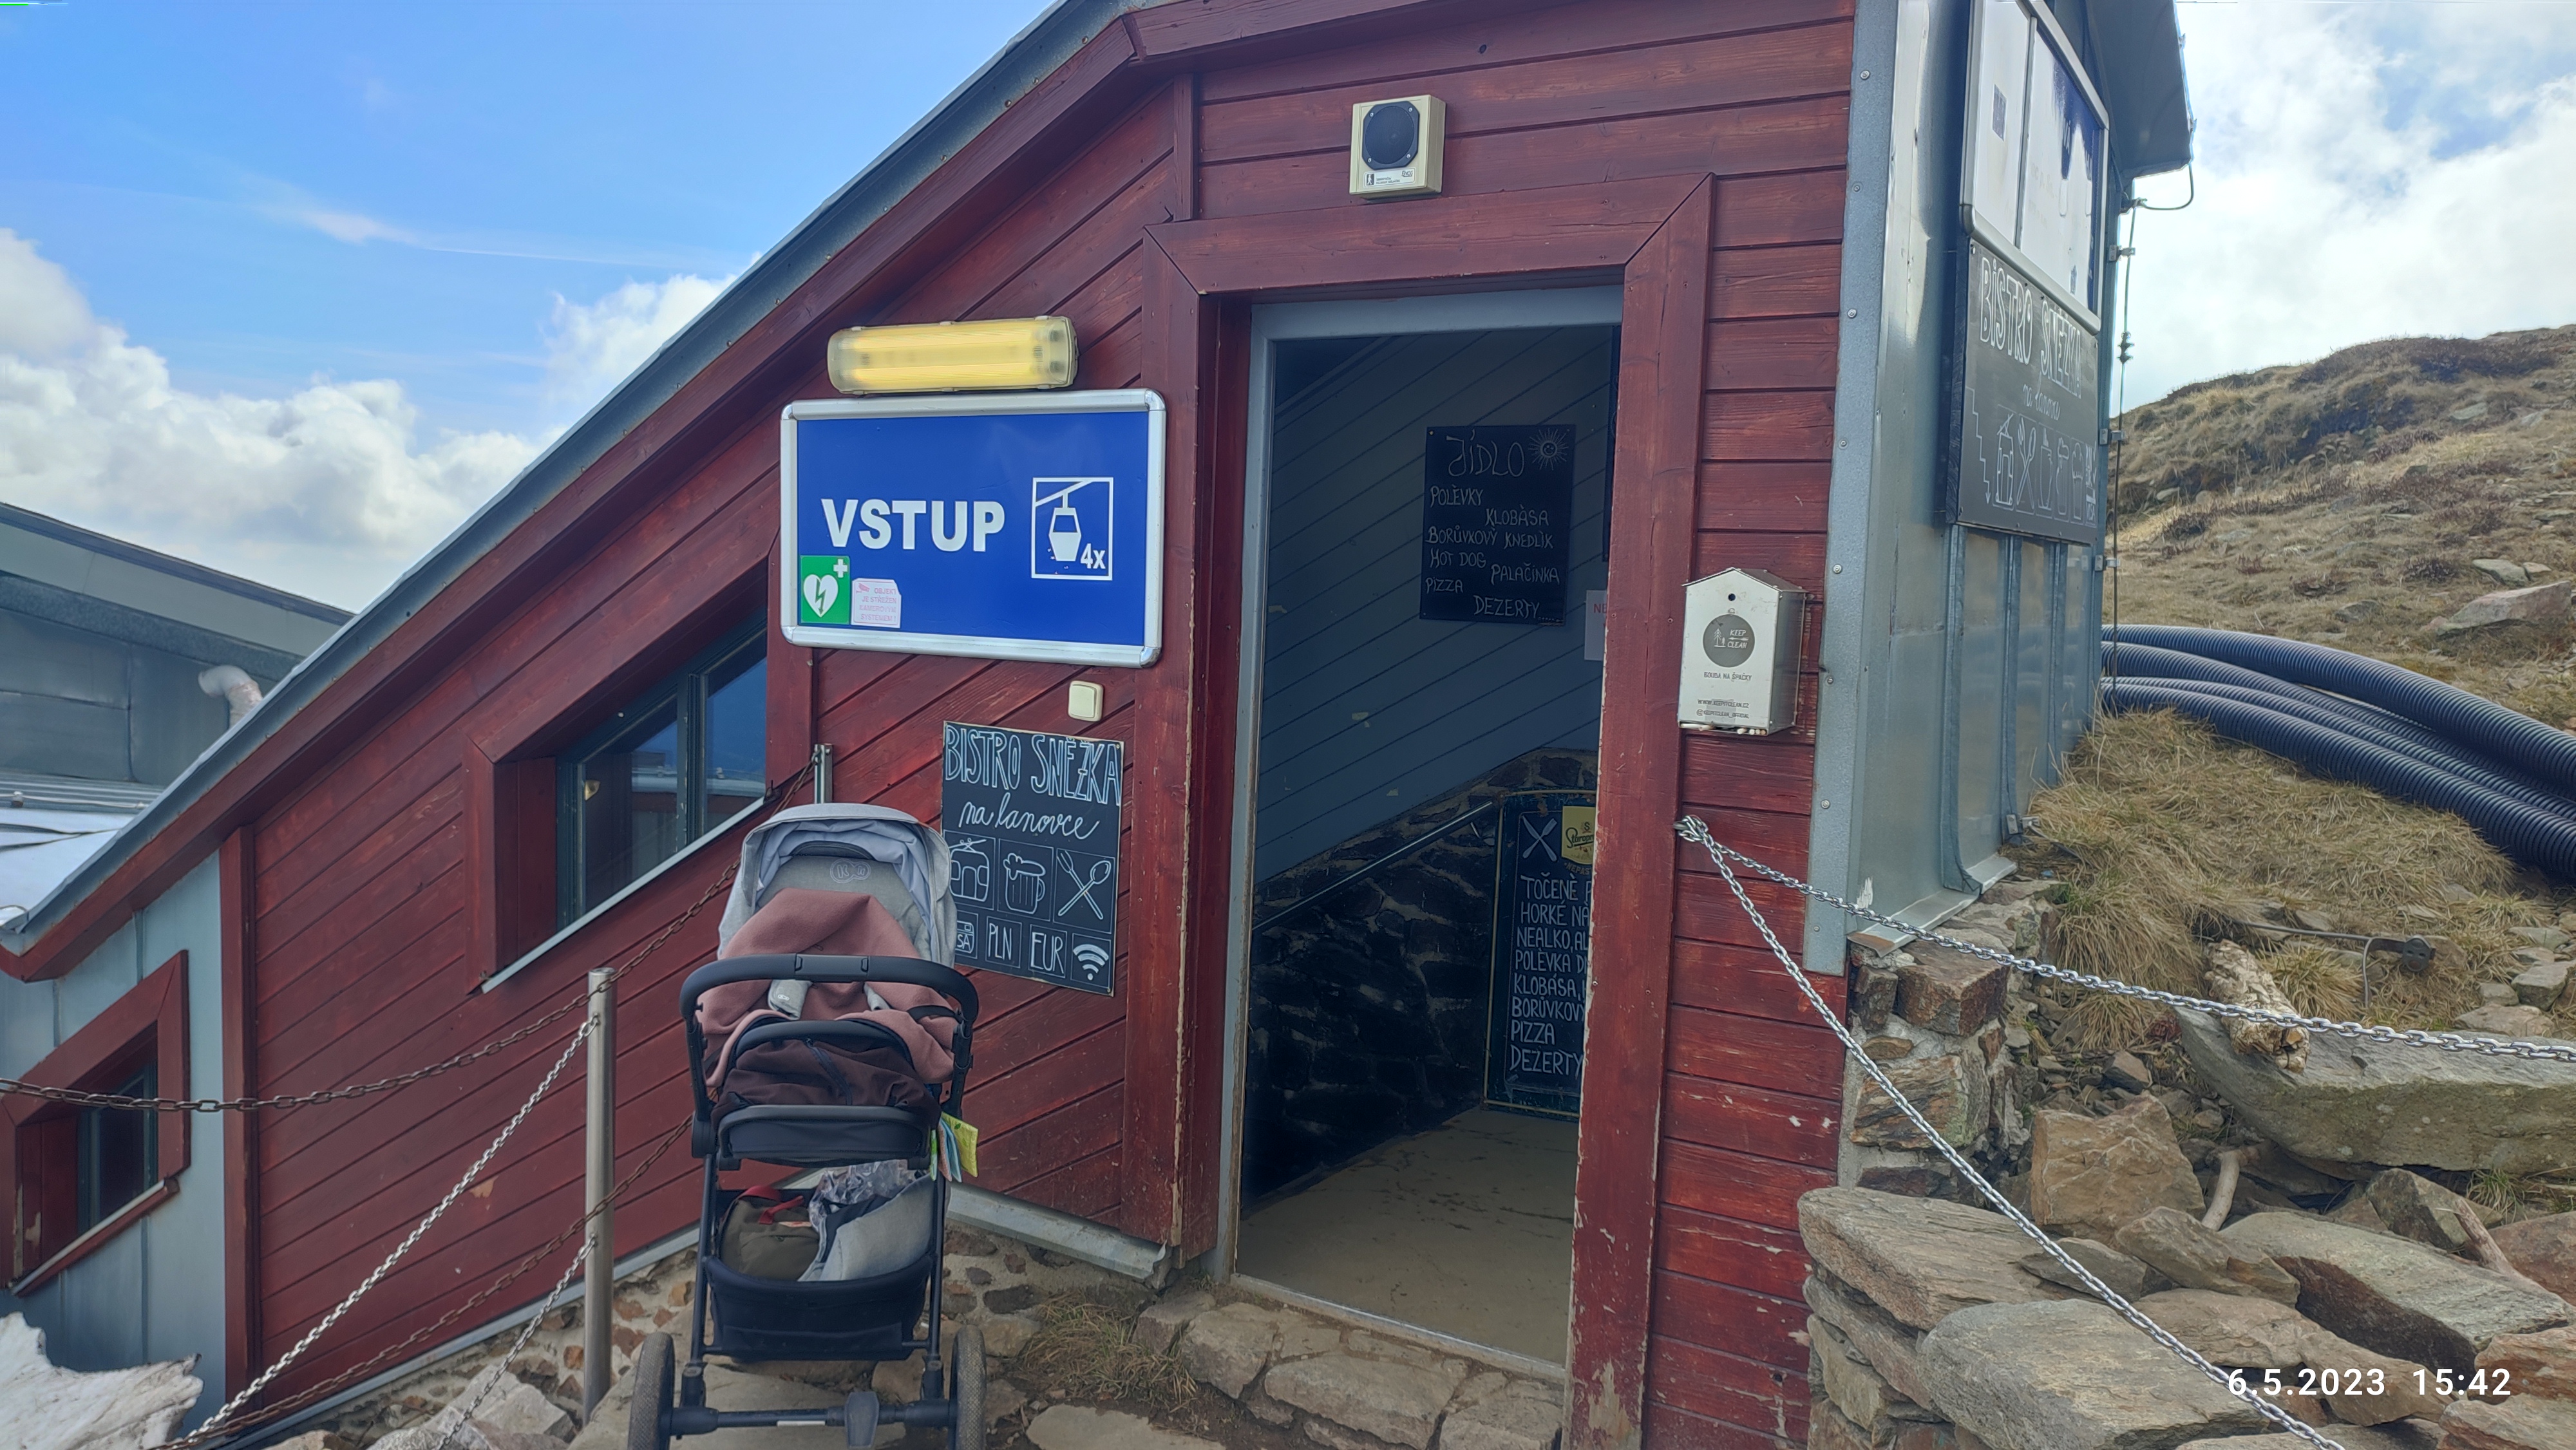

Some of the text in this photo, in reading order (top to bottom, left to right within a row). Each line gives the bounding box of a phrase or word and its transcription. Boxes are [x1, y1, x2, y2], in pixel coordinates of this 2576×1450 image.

[1980, 256, 2033, 365] BISTRO
[1446, 428, 1524, 477] JÍDLO
[822, 498, 1005, 552] VSTUP
[1080, 543, 1106, 569] 4x
[1430, 547, 1486, 569] HOT DOG
[1473, 594, 1540, 619] DEZERTY
[1727, 641, 1748, 649] CLEAN
[945, 724, 1122, 806] BISTRO SNĚŽKA
[958, 791, 1100, 840] na lanovce
[1520, 899, 1567, 926] HORKÉ
[988, 922, 1012, 961] PLN
[1030, 931, 1065, 974] EUR
[1511, 1019, 1555, 1045] PIZZA
[1510, 1044, 1584, 1080] DEZERTY
